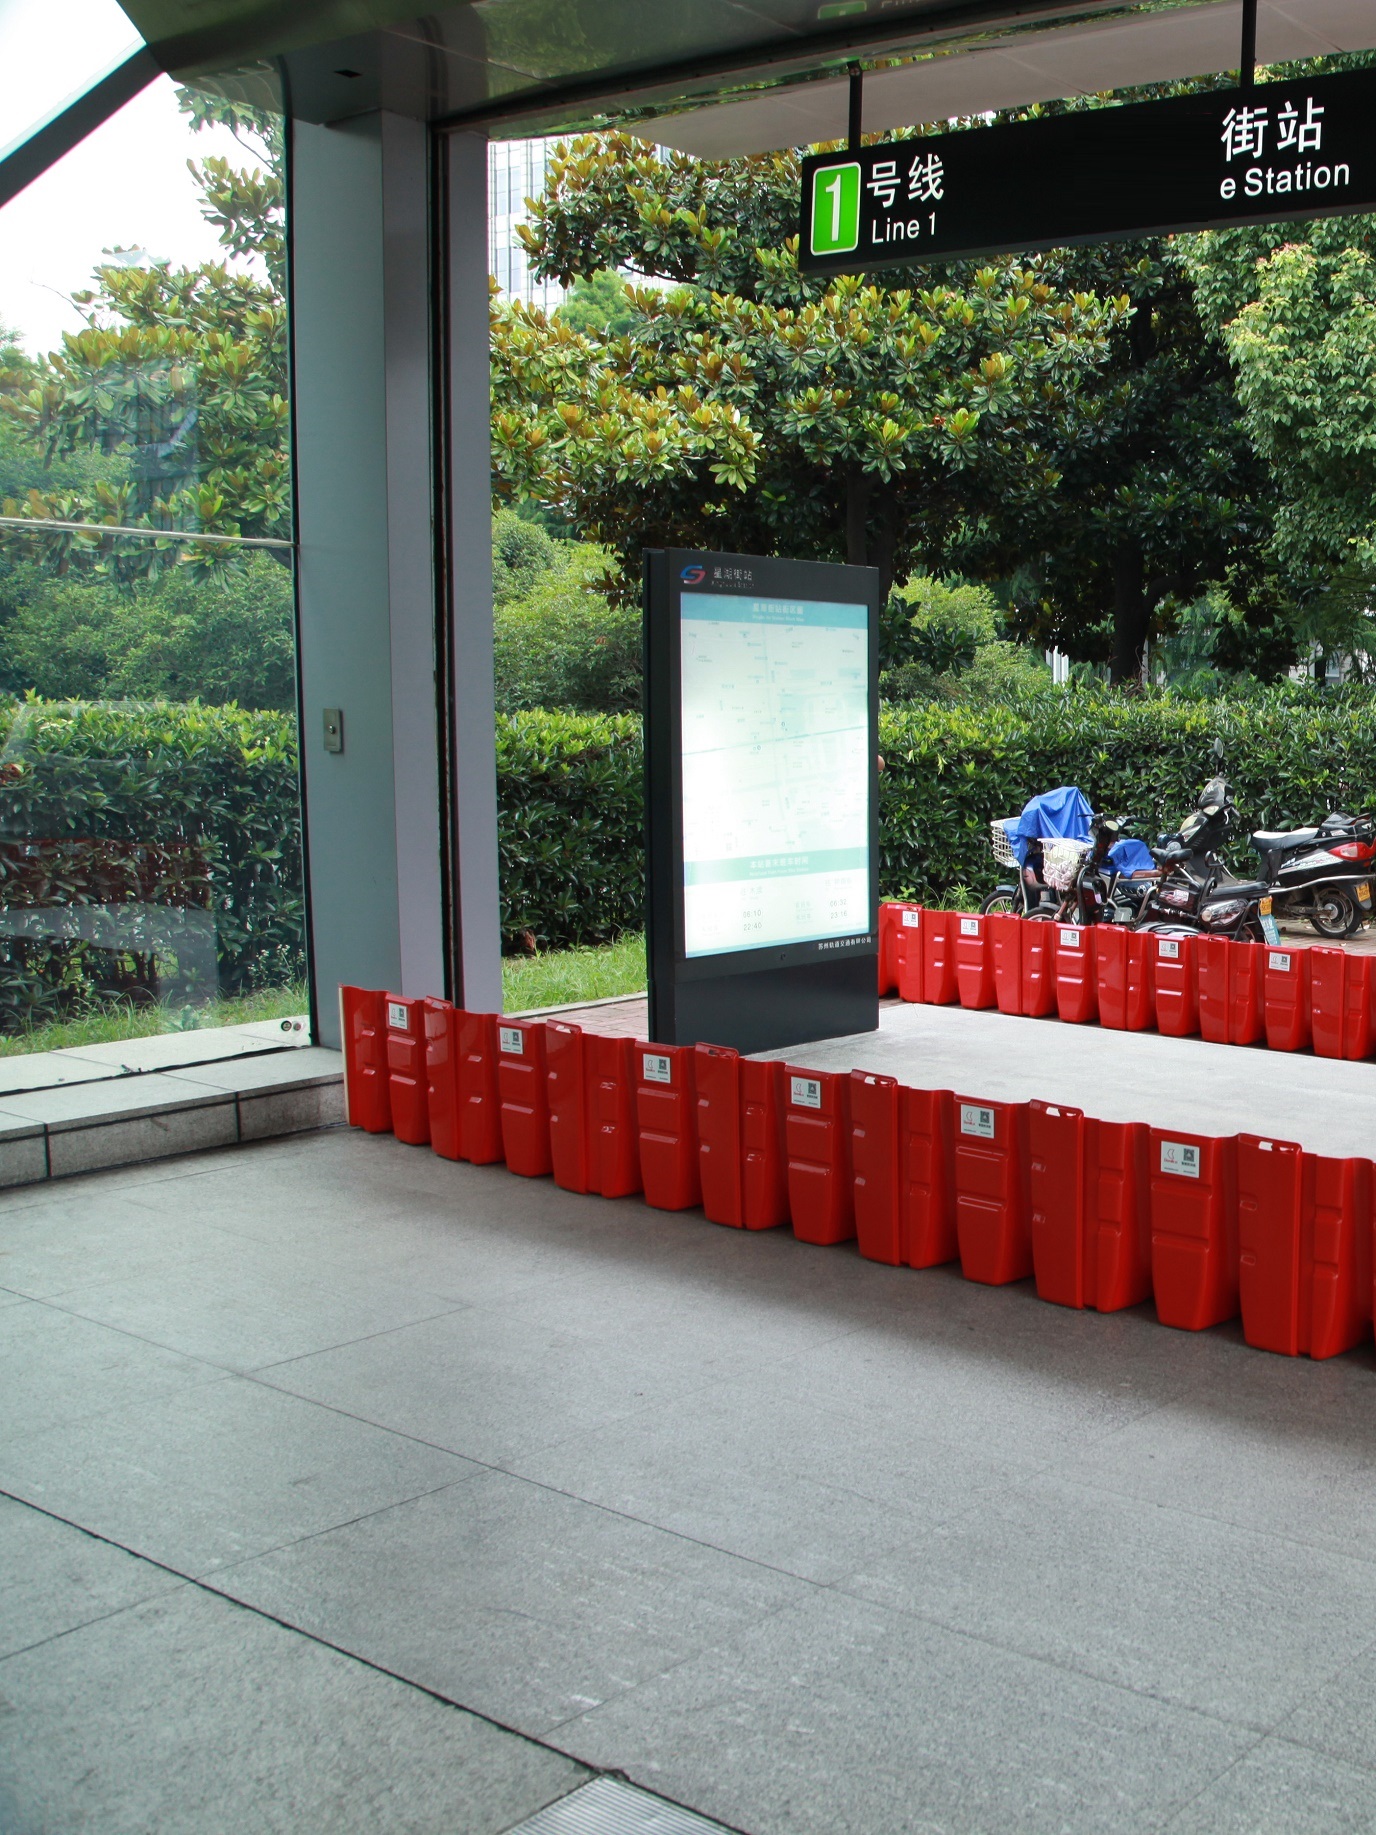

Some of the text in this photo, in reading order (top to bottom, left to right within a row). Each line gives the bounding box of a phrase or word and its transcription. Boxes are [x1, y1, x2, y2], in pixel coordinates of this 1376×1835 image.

[1220, 96, 1325, 162] 街站
[824, 154, 945, 242] 1 号线
[1220, 155, 1350, 200] e Station
[872, 212, 937, 244] Line 1
